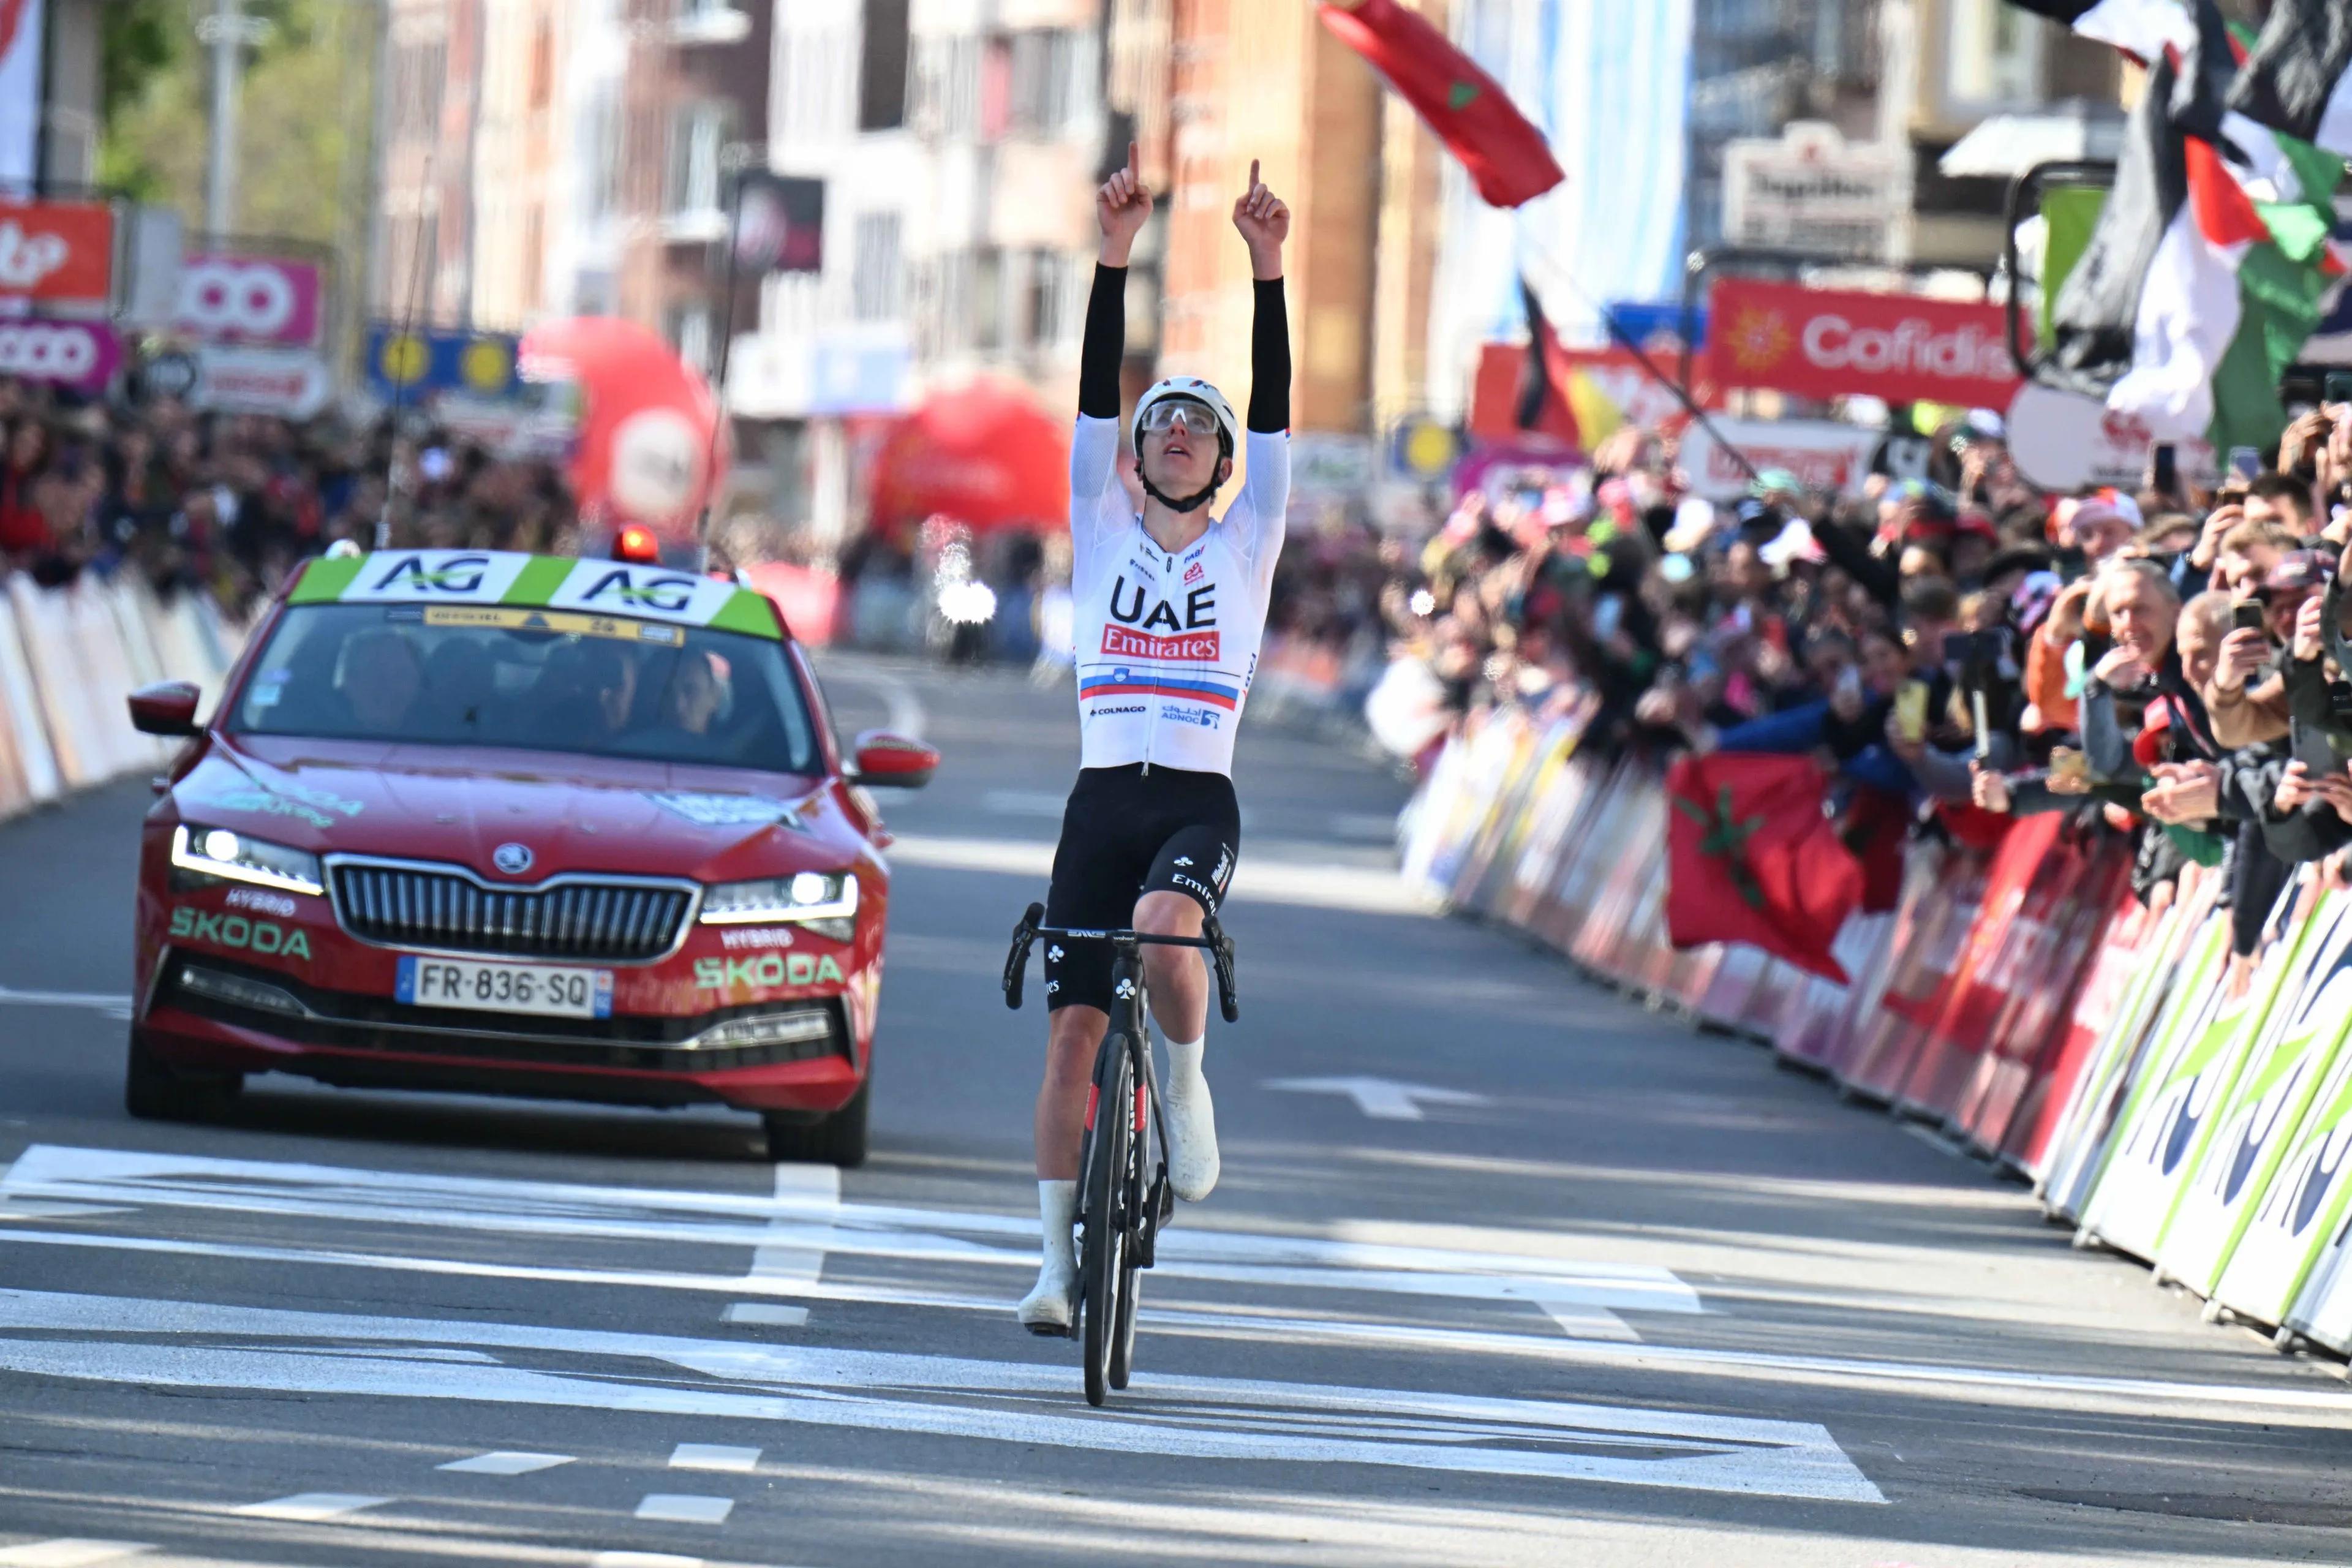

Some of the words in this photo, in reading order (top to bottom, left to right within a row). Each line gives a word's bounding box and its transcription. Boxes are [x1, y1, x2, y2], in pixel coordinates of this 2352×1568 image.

[1803, 313, 2018, 381] Cofidis
[372, 555, 489, 592] AG
[580, 569, 697, 611] AG
[1110, 575, 1216, 631] UAE
[1105, 629, 1216, 658] Emirates
[1098, 706, 1146, 715] COLNAGO
[1161, 712, 1199, 724] ADNOC
[420, 963, 589, 1008] FR-836-SQ
